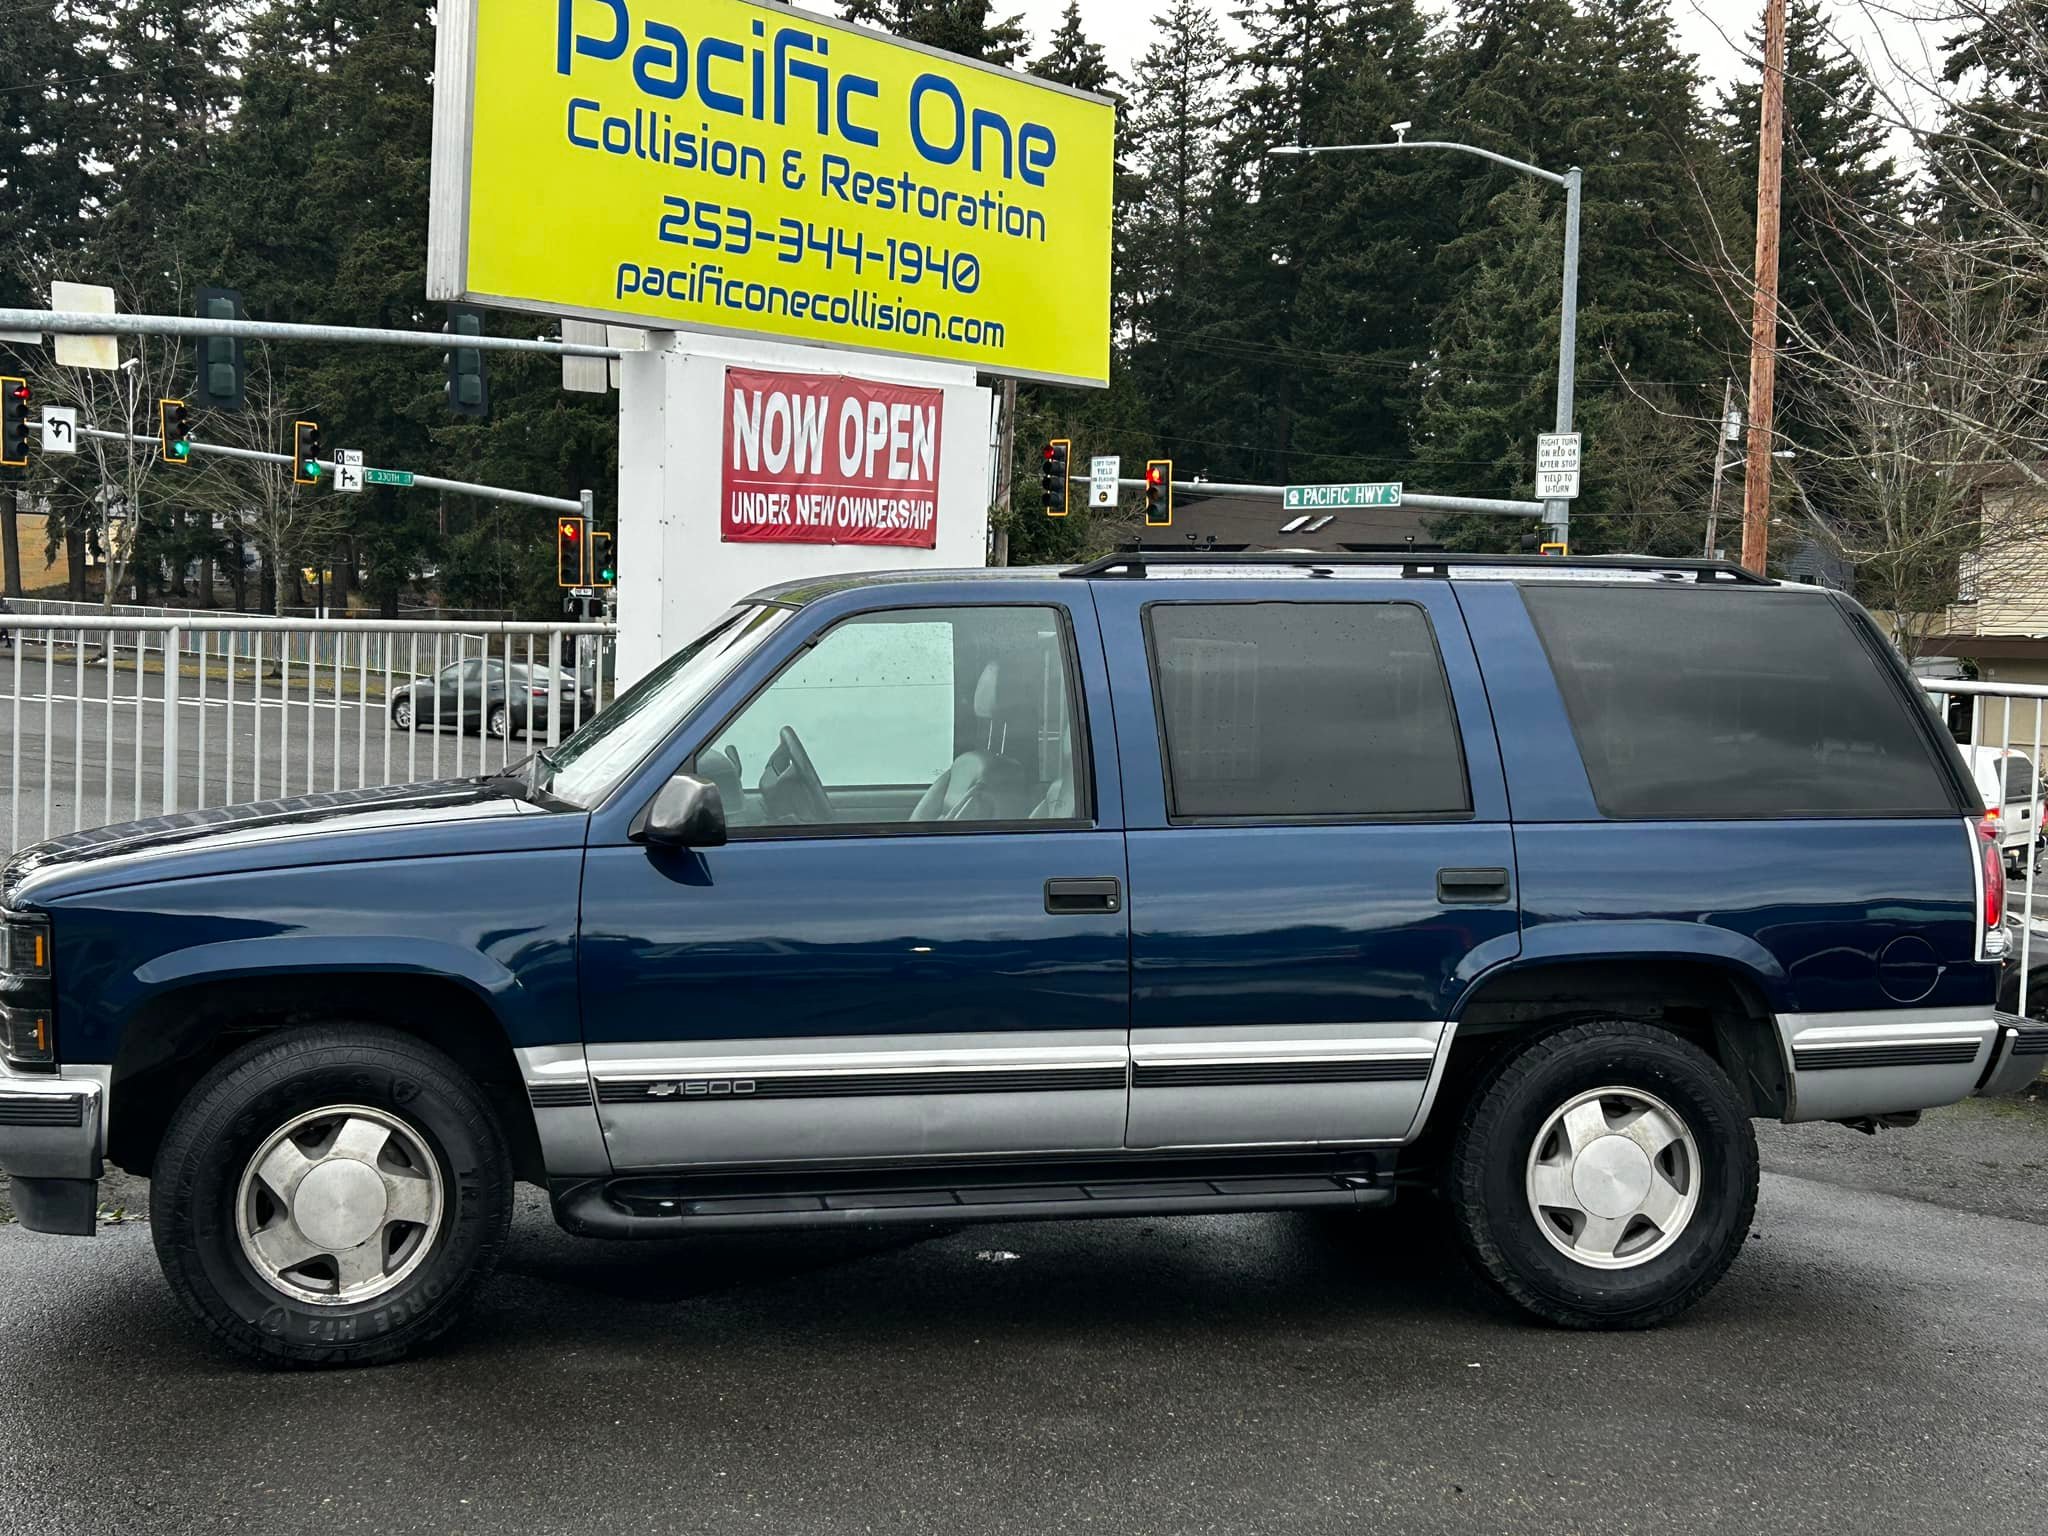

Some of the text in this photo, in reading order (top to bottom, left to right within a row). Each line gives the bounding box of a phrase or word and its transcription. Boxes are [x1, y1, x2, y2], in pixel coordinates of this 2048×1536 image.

[557, 0, 1057, 187] Pacific One
[568, 98, 1046, 242] Collision & Restoration
[658, 194, 980, 294] 253-344-1940
[616, 262, 1005, 348] pacificonecollision.com
[733, 388, 937, 482] NOW OPEN
[1541, 438, 1578, 447] RIGHT TURN
[1541, 449, 1550, 457] ON
[1540, 460, 1577, 468] AFTER STOP
[1544, 473, 1573, 483] YIELD TO
[1303, 485, 1399, 505] PACIFIC HWY S
[1545, 484, 1570, 493] U-TURN
[731, 491, 934, 530] UNDER NEW OWNERSHIP
[676, 1080, 756, 1095] 1500
